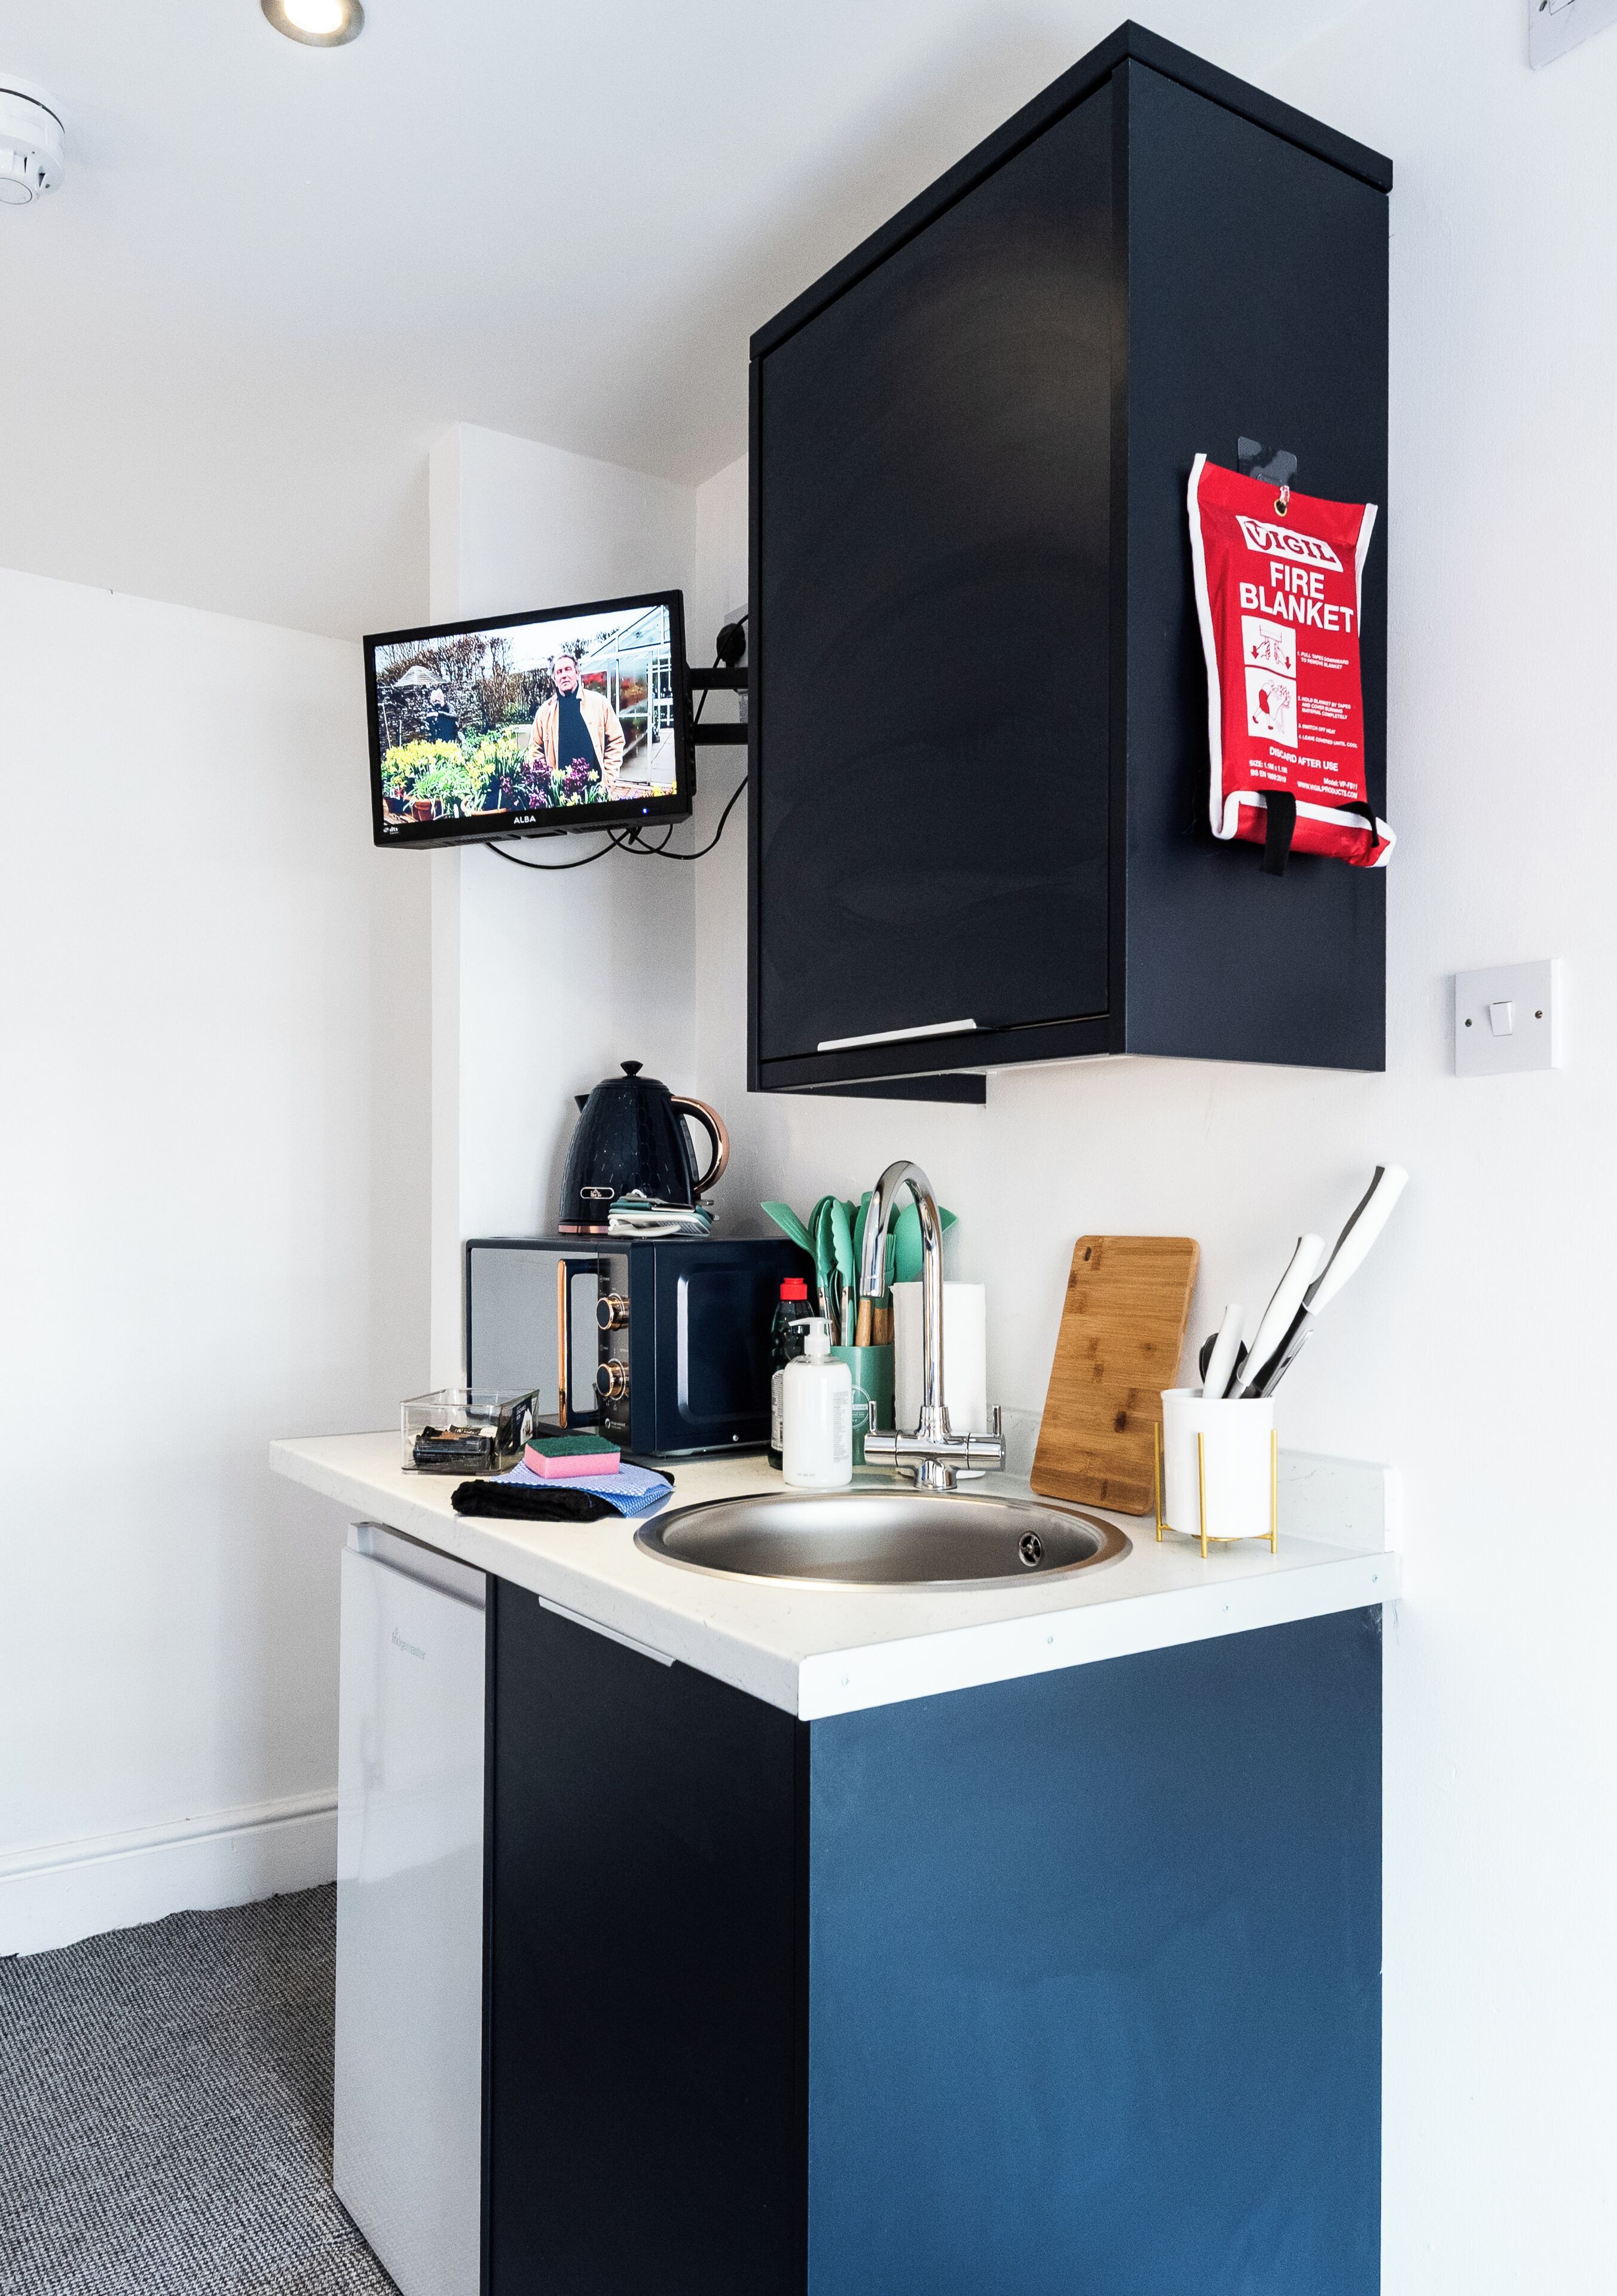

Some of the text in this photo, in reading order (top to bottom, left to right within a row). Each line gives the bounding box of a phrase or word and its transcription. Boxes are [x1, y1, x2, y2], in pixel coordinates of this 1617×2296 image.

[1244, 521, 1337, 563] VIGIL
[1270, 561, 1325, 600] FIRE
[1239, 582, 1354, 633] BLANKET
[1322, 711, 1348, 720] COMPLETELY
[1249, 759, 1264, 768] SIZE:
[1269, 746, 1338, 772] DISCARD AFTER USE
[1259, 770, 1267, 778] EN
[513, 815, 536, 825] ALBA
